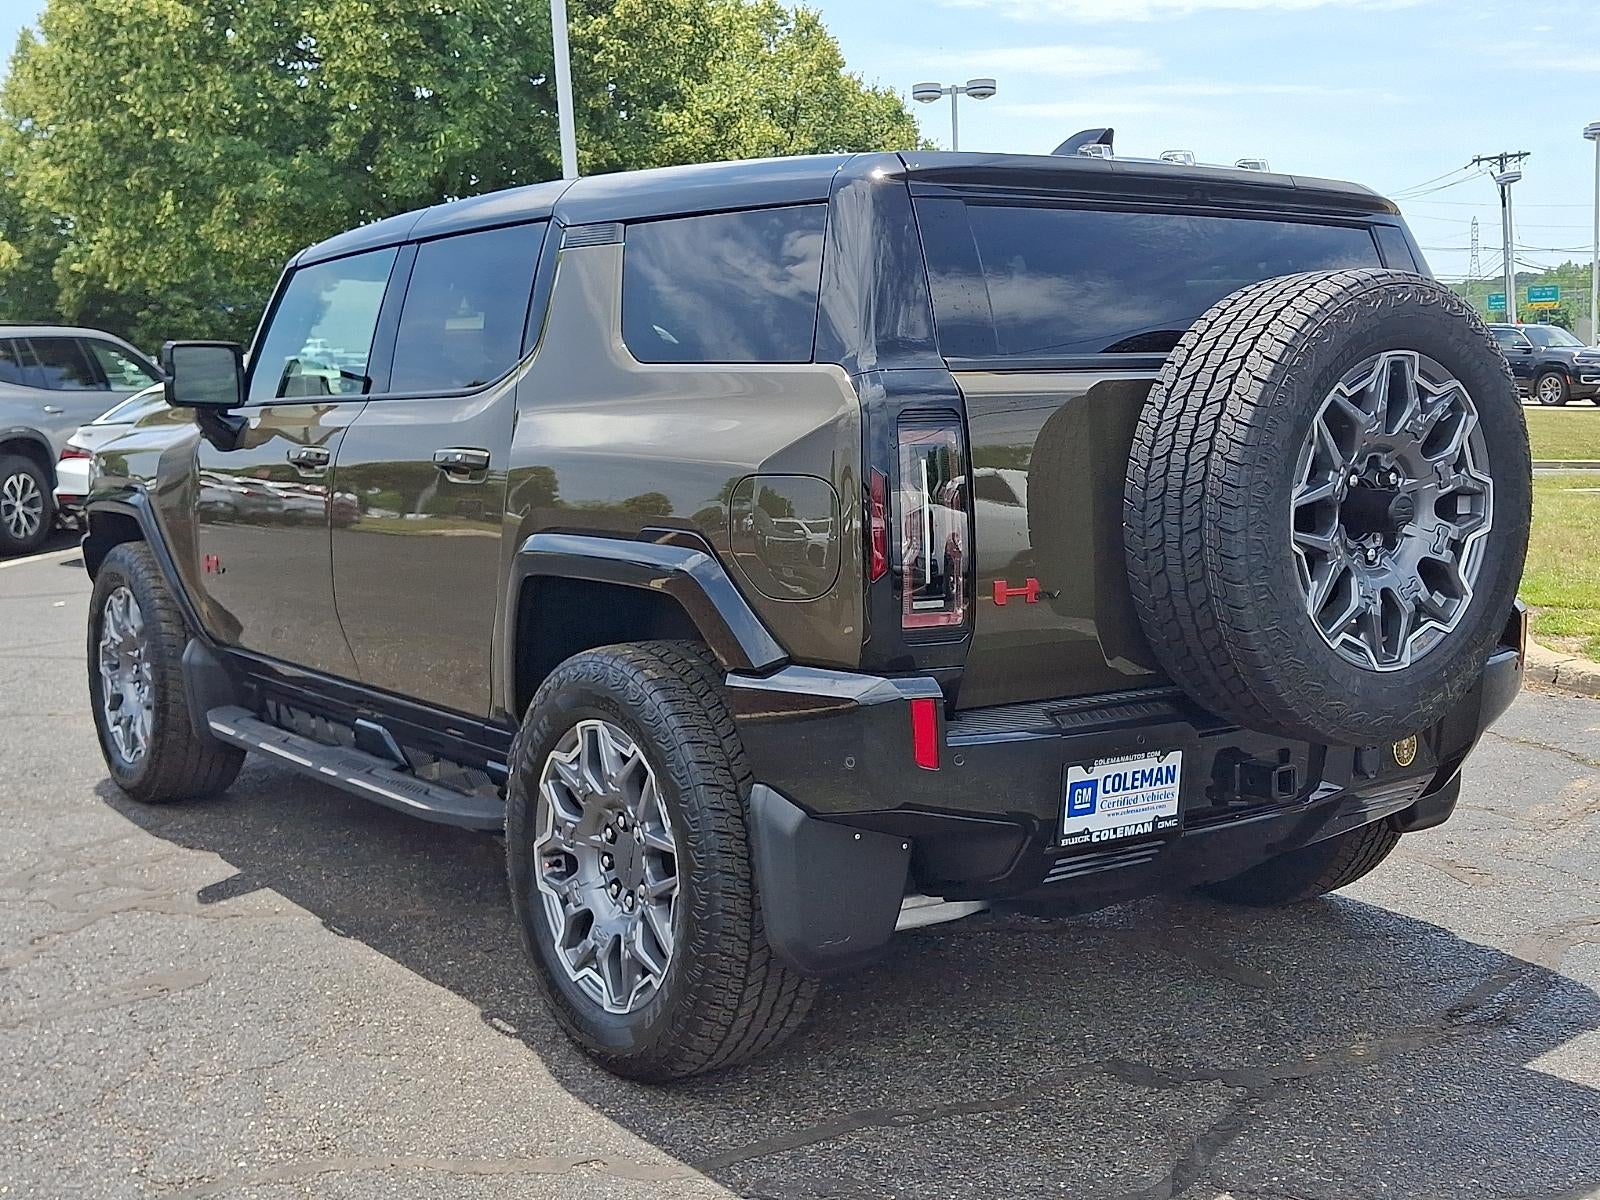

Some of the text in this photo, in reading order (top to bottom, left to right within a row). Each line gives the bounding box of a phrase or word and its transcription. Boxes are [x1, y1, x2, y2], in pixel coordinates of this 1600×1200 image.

[1102, 764, 1177, 794] COLEMAN
[1074, 786, 1092, 805] GM
[1100, 790, 1175, 810] Certified Vehicles
[1061, 819, 1179, 847] BUICK COLEMAN GMC
